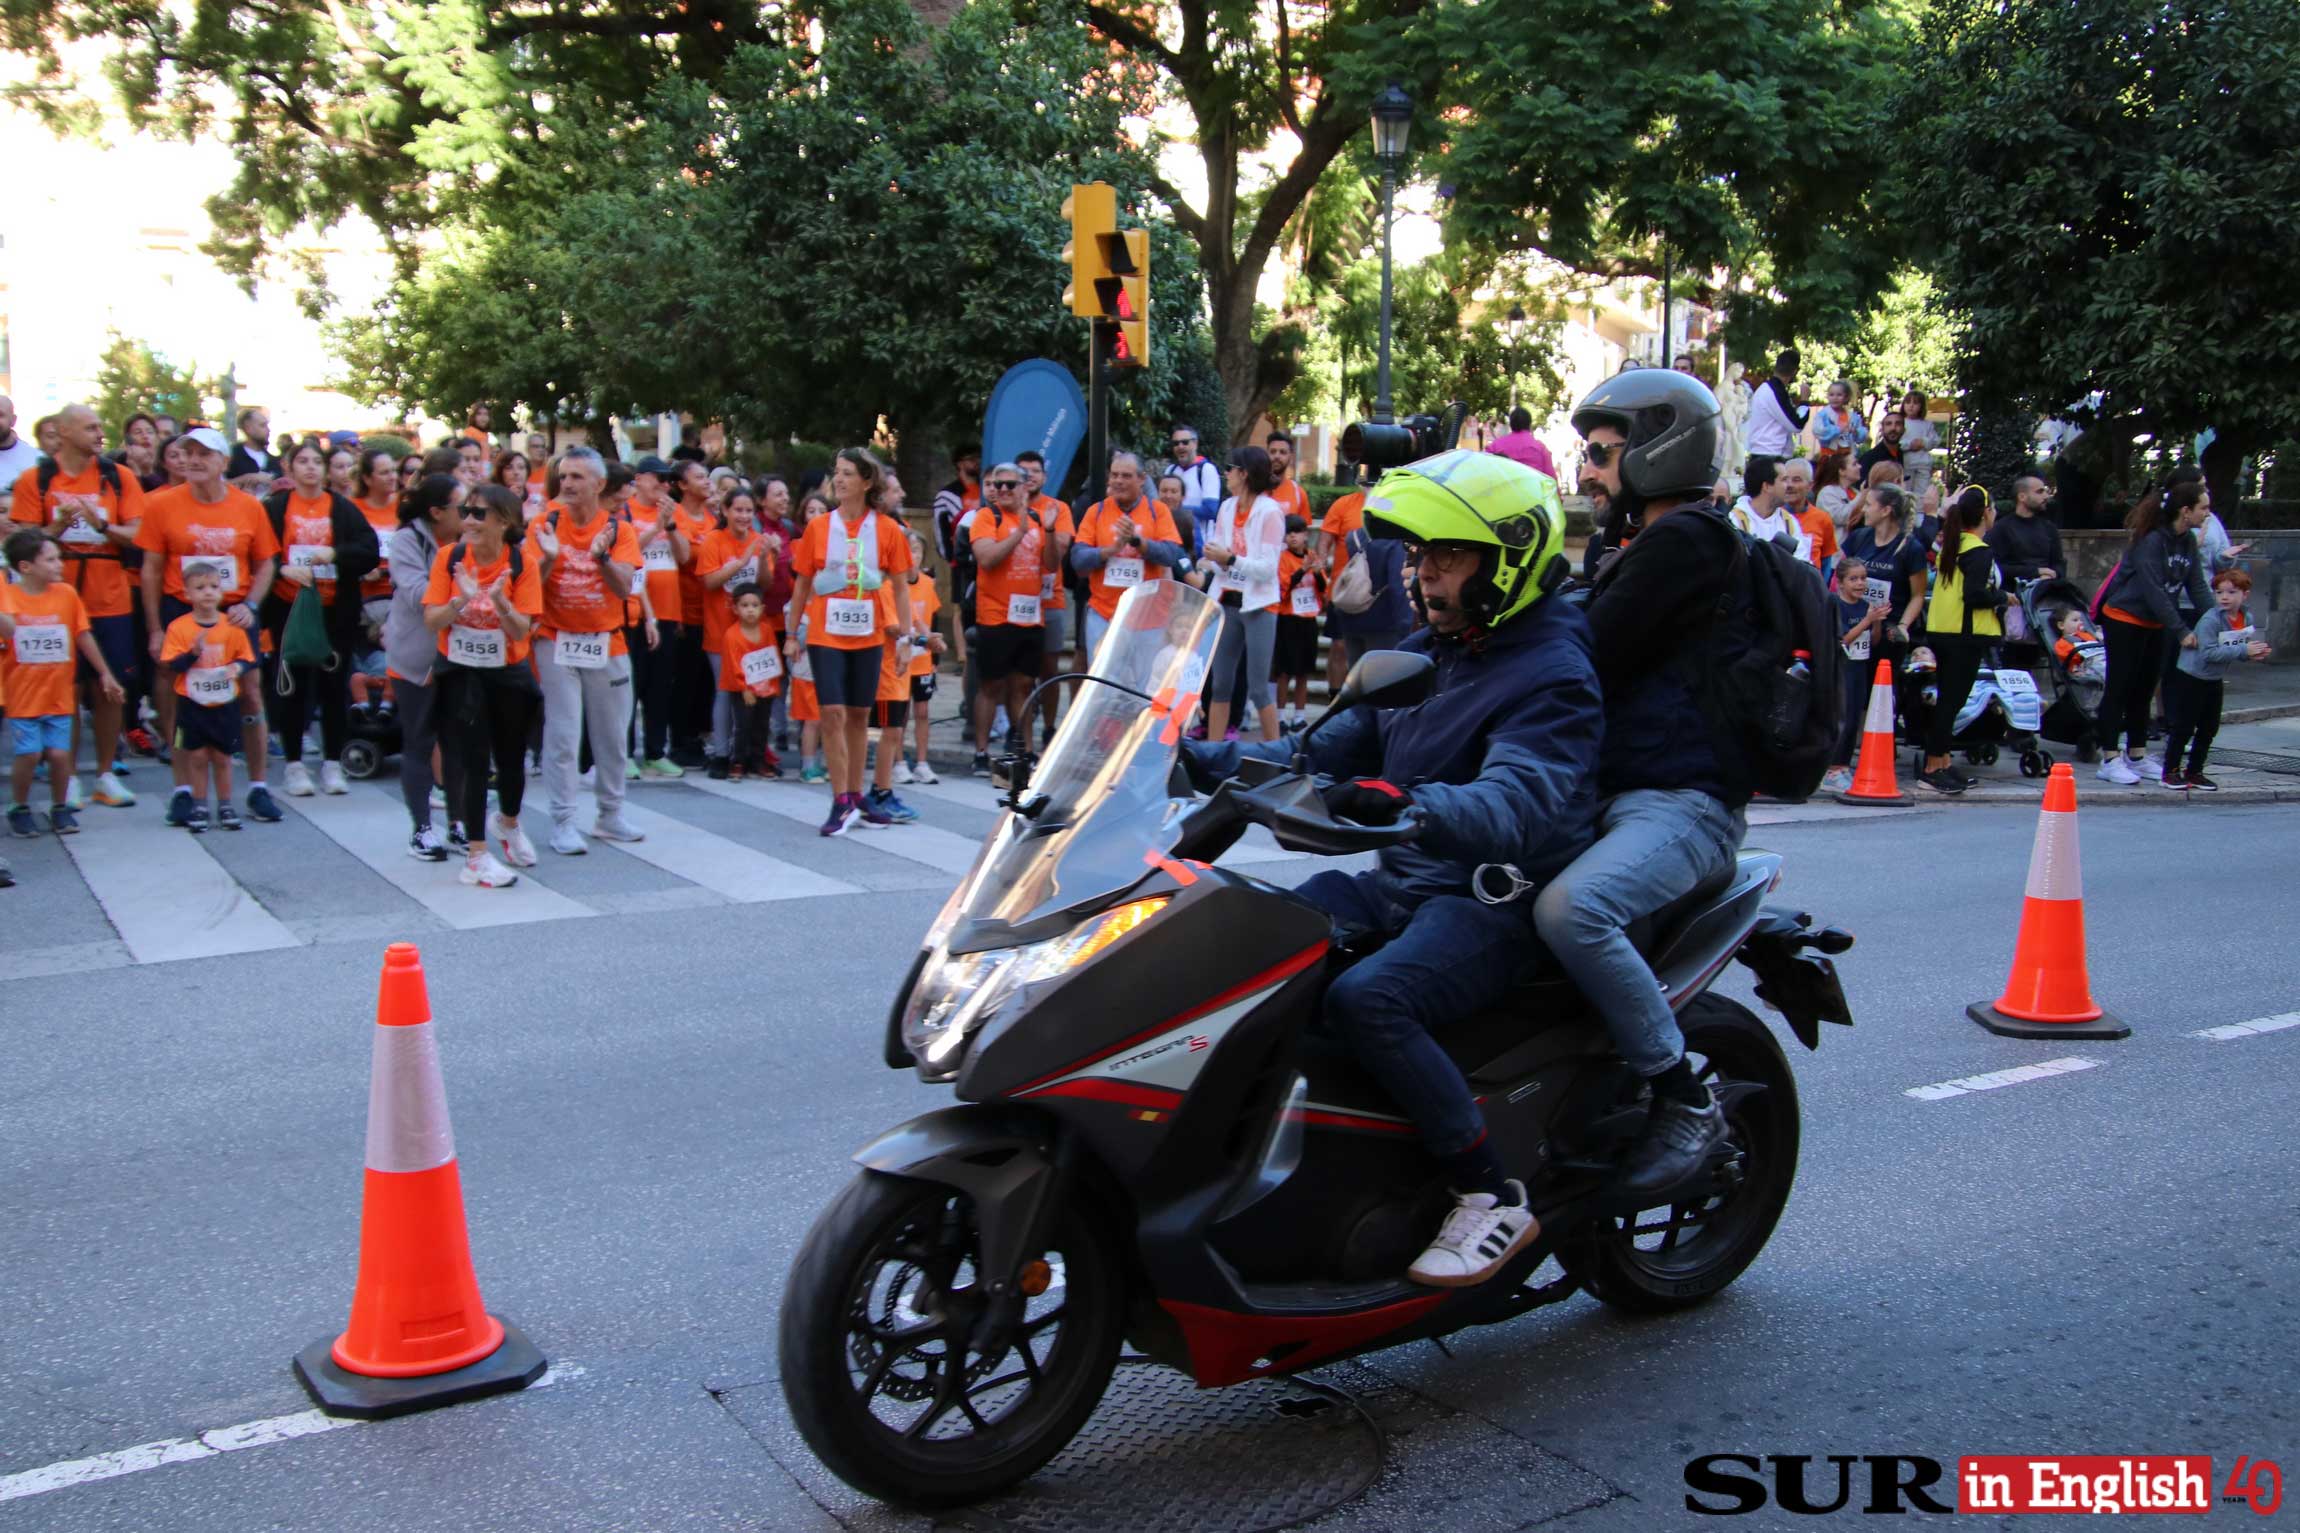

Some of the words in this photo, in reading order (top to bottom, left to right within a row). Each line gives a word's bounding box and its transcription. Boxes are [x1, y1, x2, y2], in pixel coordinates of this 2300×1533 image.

[832, 611, 870, 624] 1933
[21, 638, 63, 651] 1725
[455, 639, 499, 655] 1858
[562, 641, 602, 656] 1748
